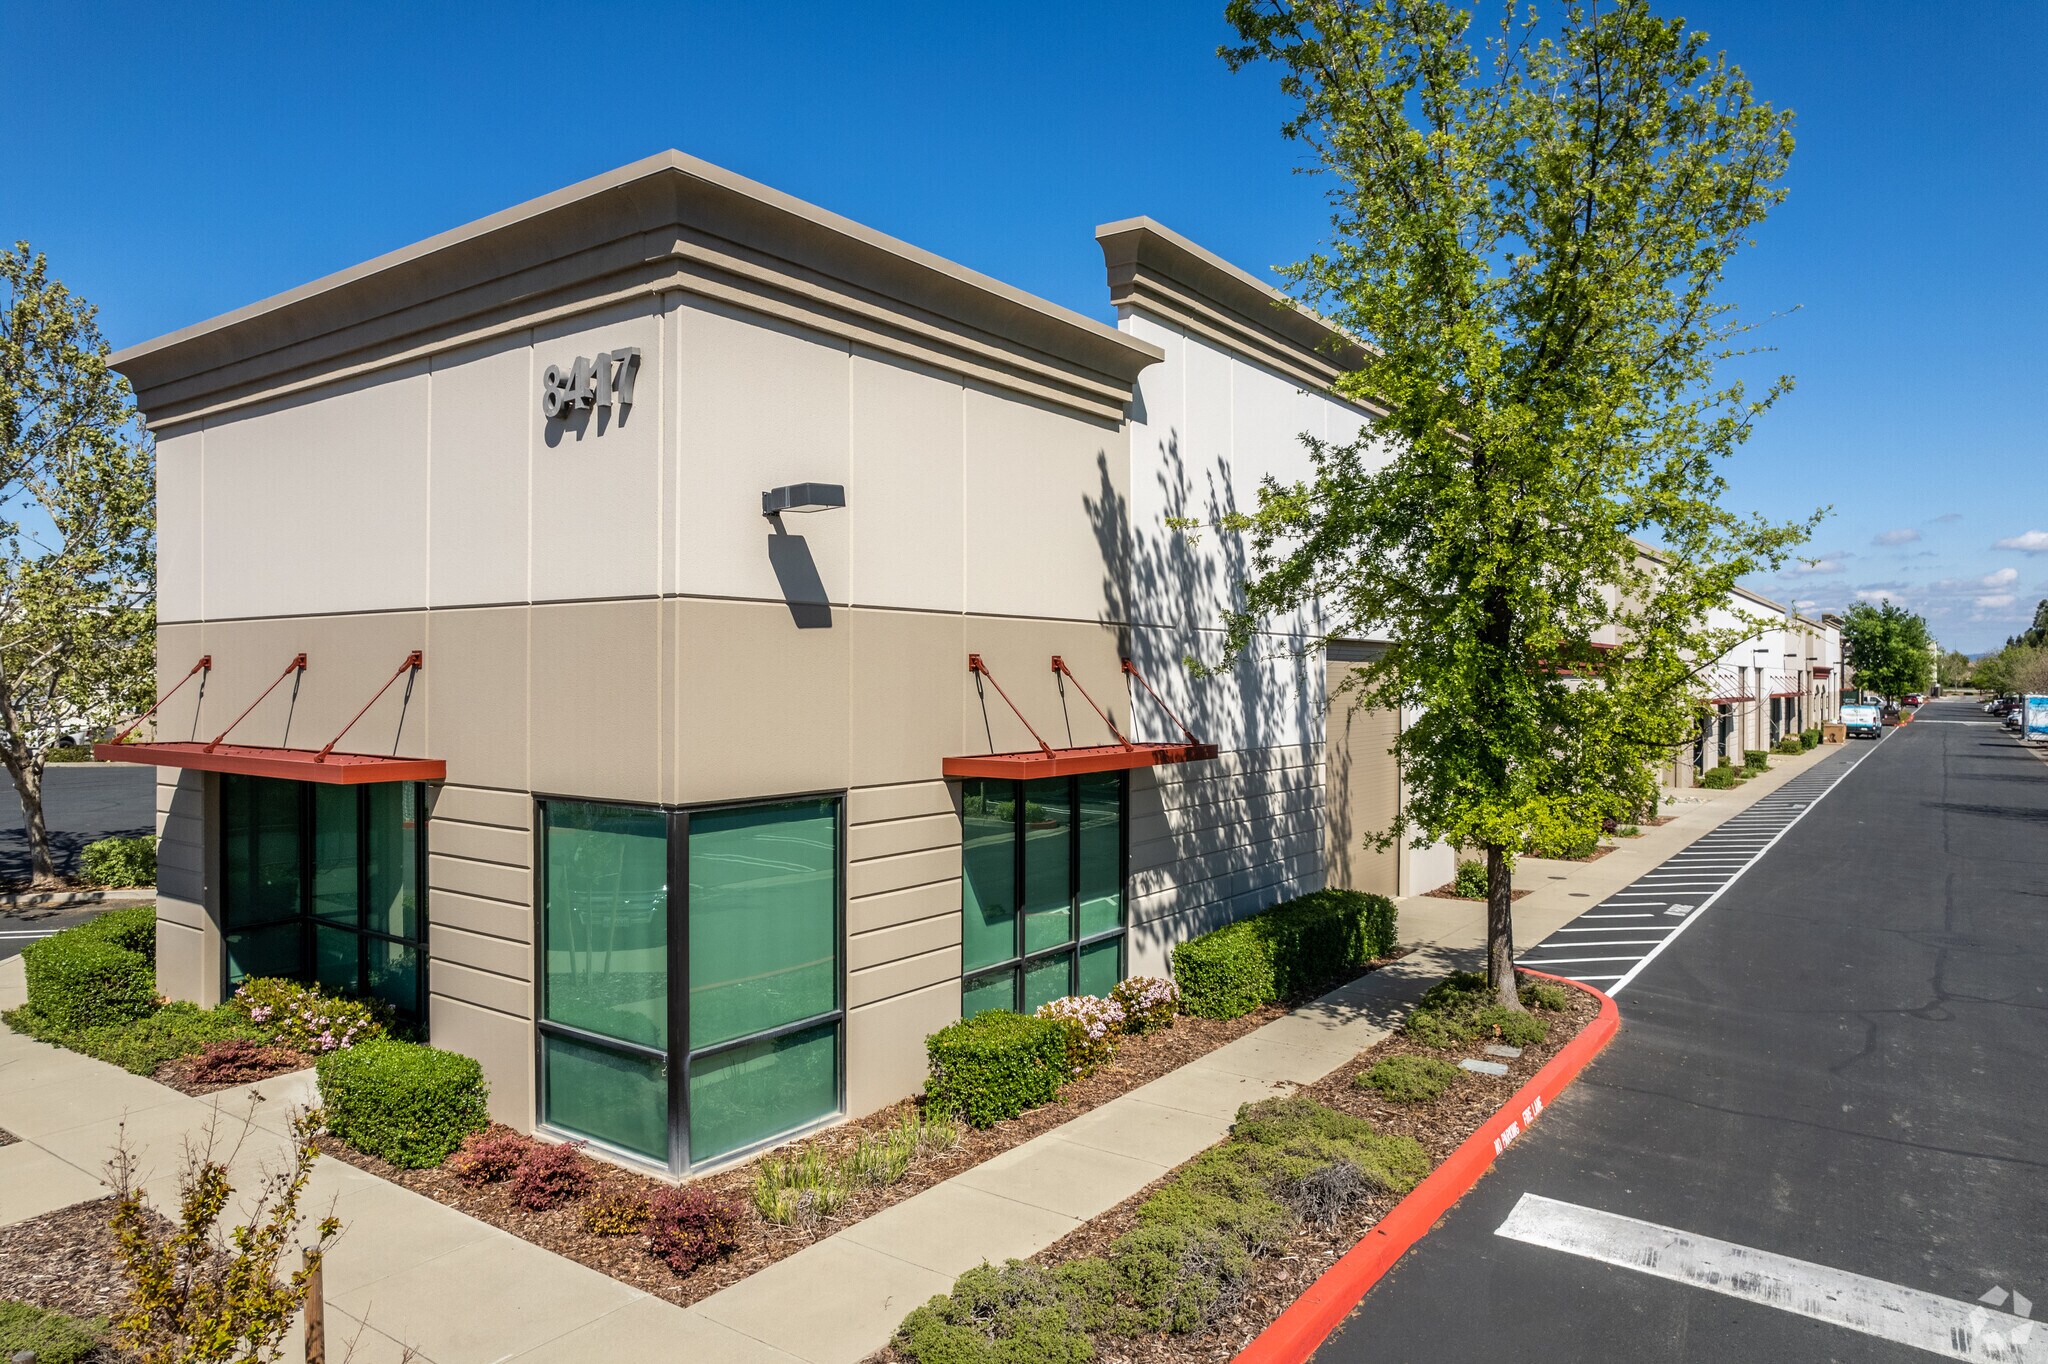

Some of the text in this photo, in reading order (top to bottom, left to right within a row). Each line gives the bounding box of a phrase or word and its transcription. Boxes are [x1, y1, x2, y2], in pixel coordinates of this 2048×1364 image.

[543, 346, 641, 418] 8417
[1493, 1095, 1544, 1156] NO PARKING FIRE LANE
